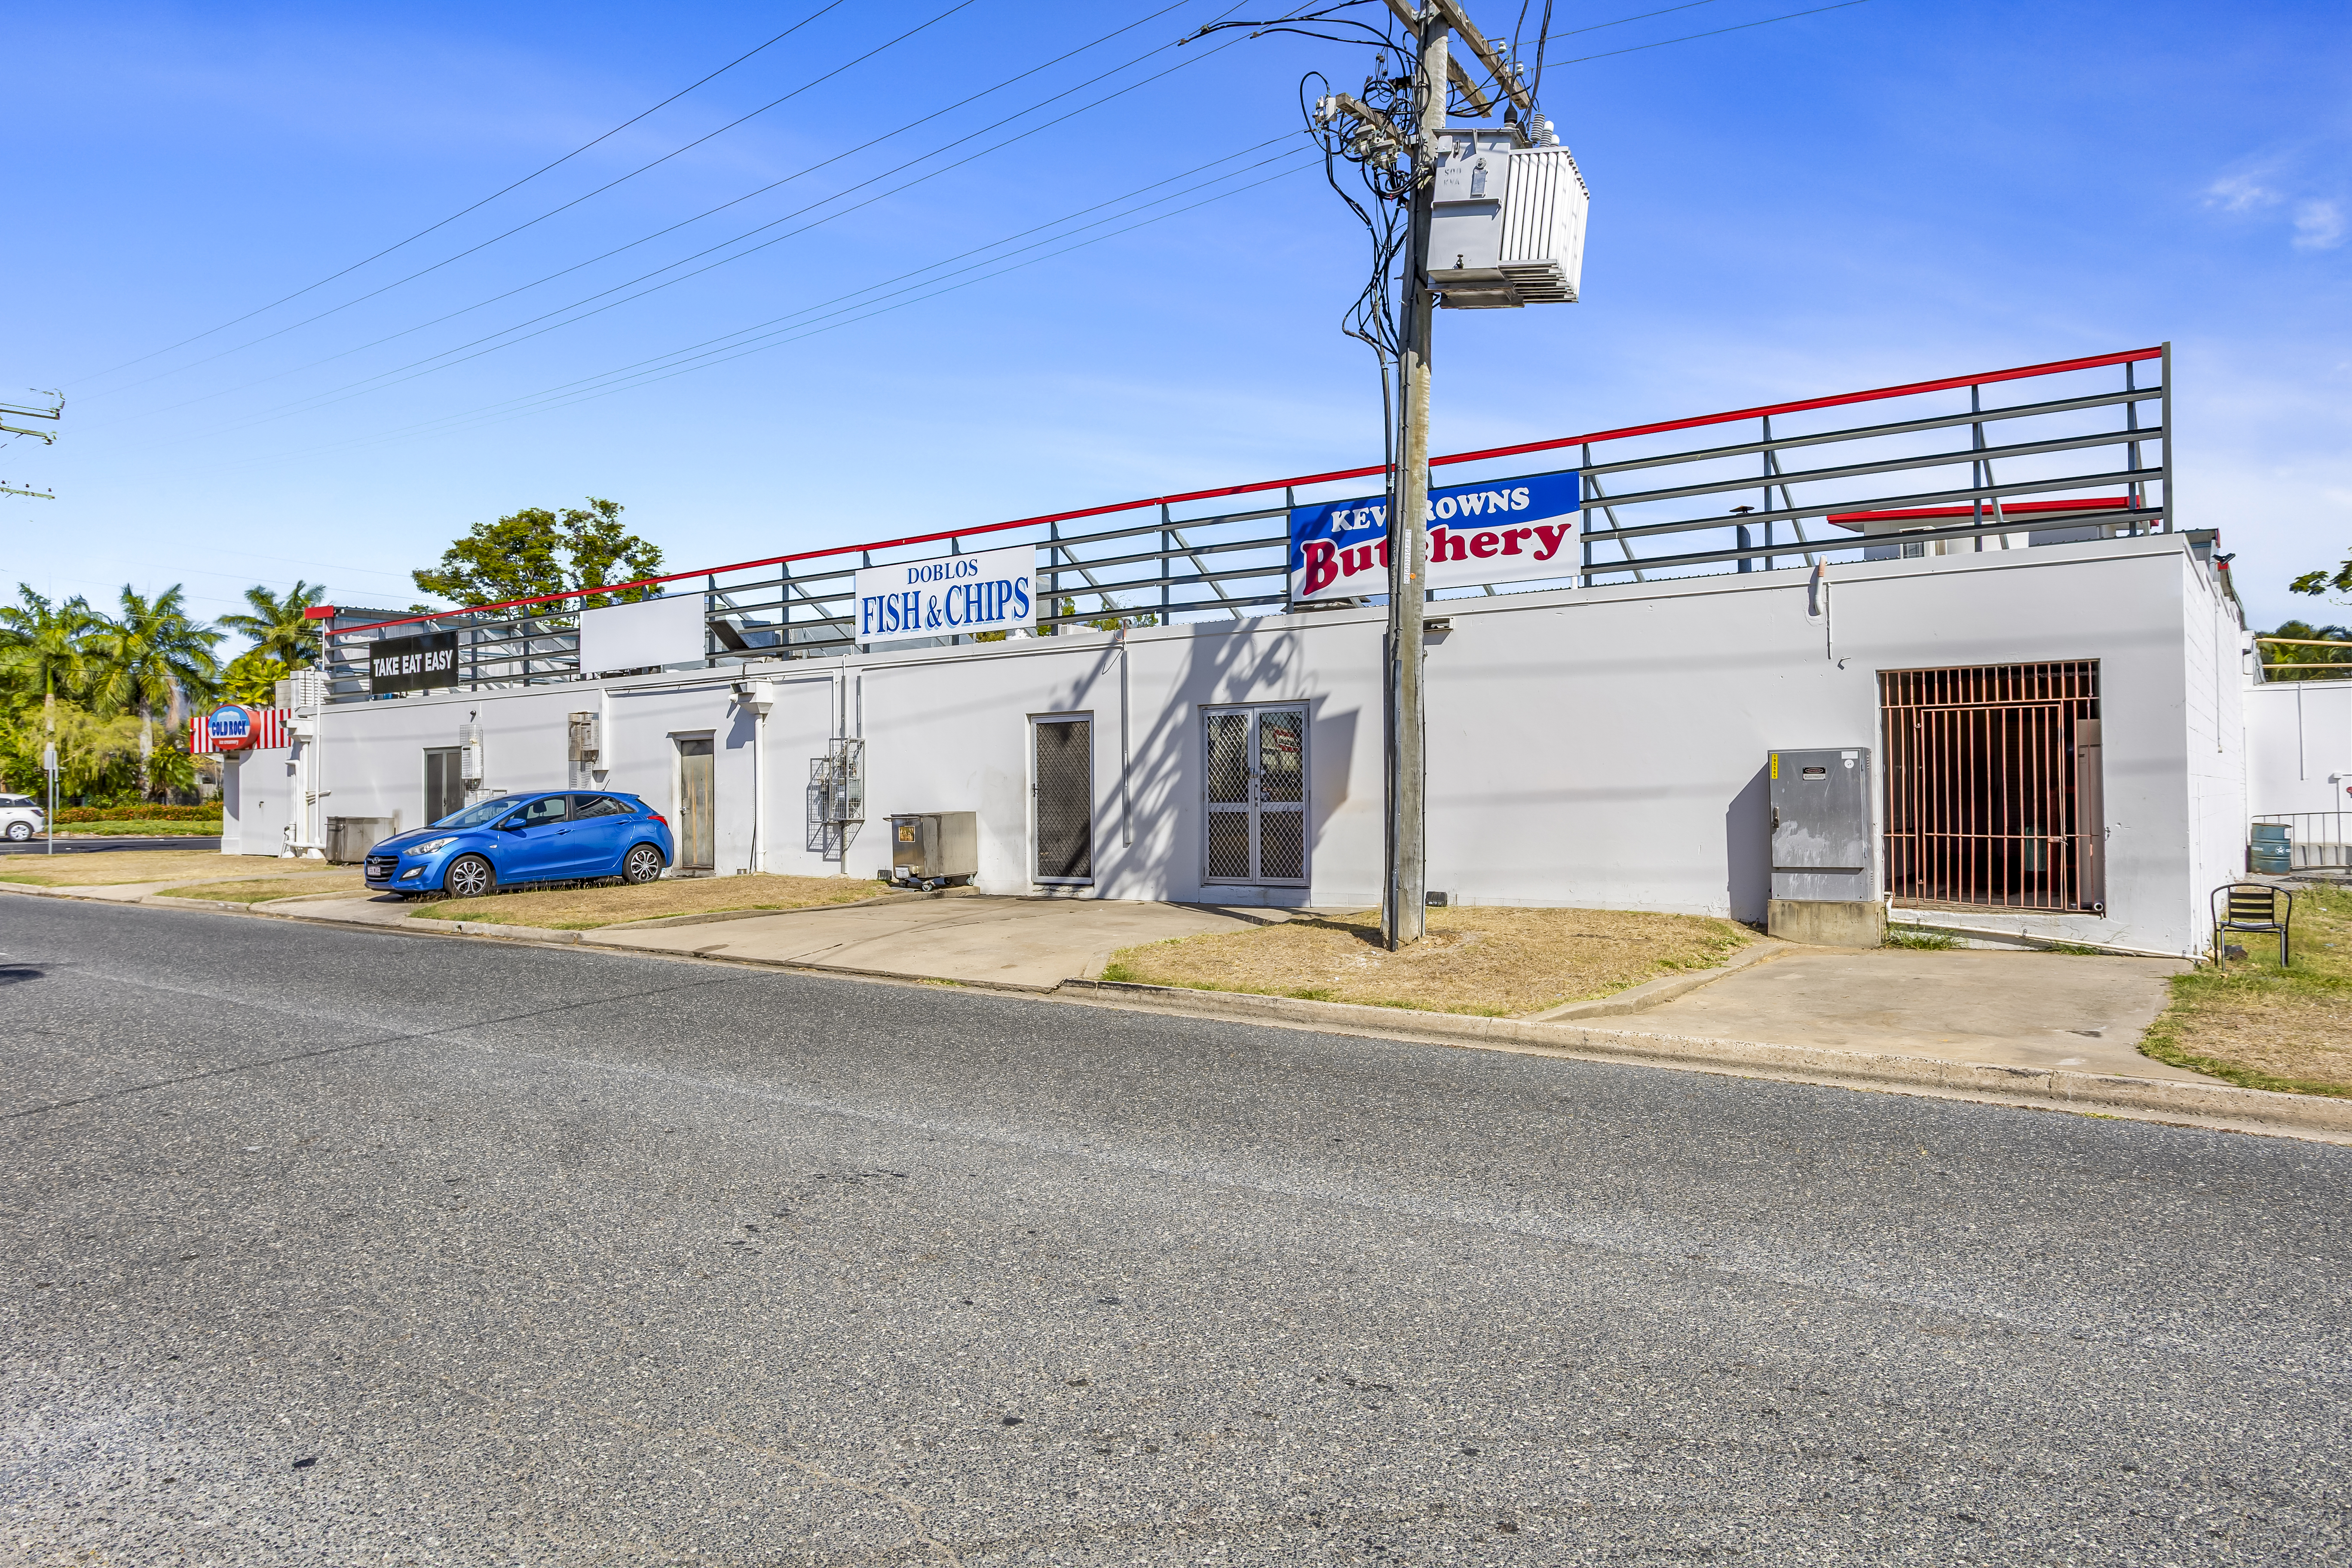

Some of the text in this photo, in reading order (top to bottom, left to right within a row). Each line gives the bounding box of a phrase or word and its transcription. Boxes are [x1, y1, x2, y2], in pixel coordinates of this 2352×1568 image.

[1445, 168, 1461, 176] 500
[1331, 487, 1530, 533] KEV ROWNS
[906, 559, 978, 585] DOBLOS
[1302, 523, 1572, 596] Buthery
[861, 576, 1030, 637] FISH & CHIPS
[373, 649, 453, 677] TAKE EAT EASY
[212, 720, 247, 736] COLD ROCK
